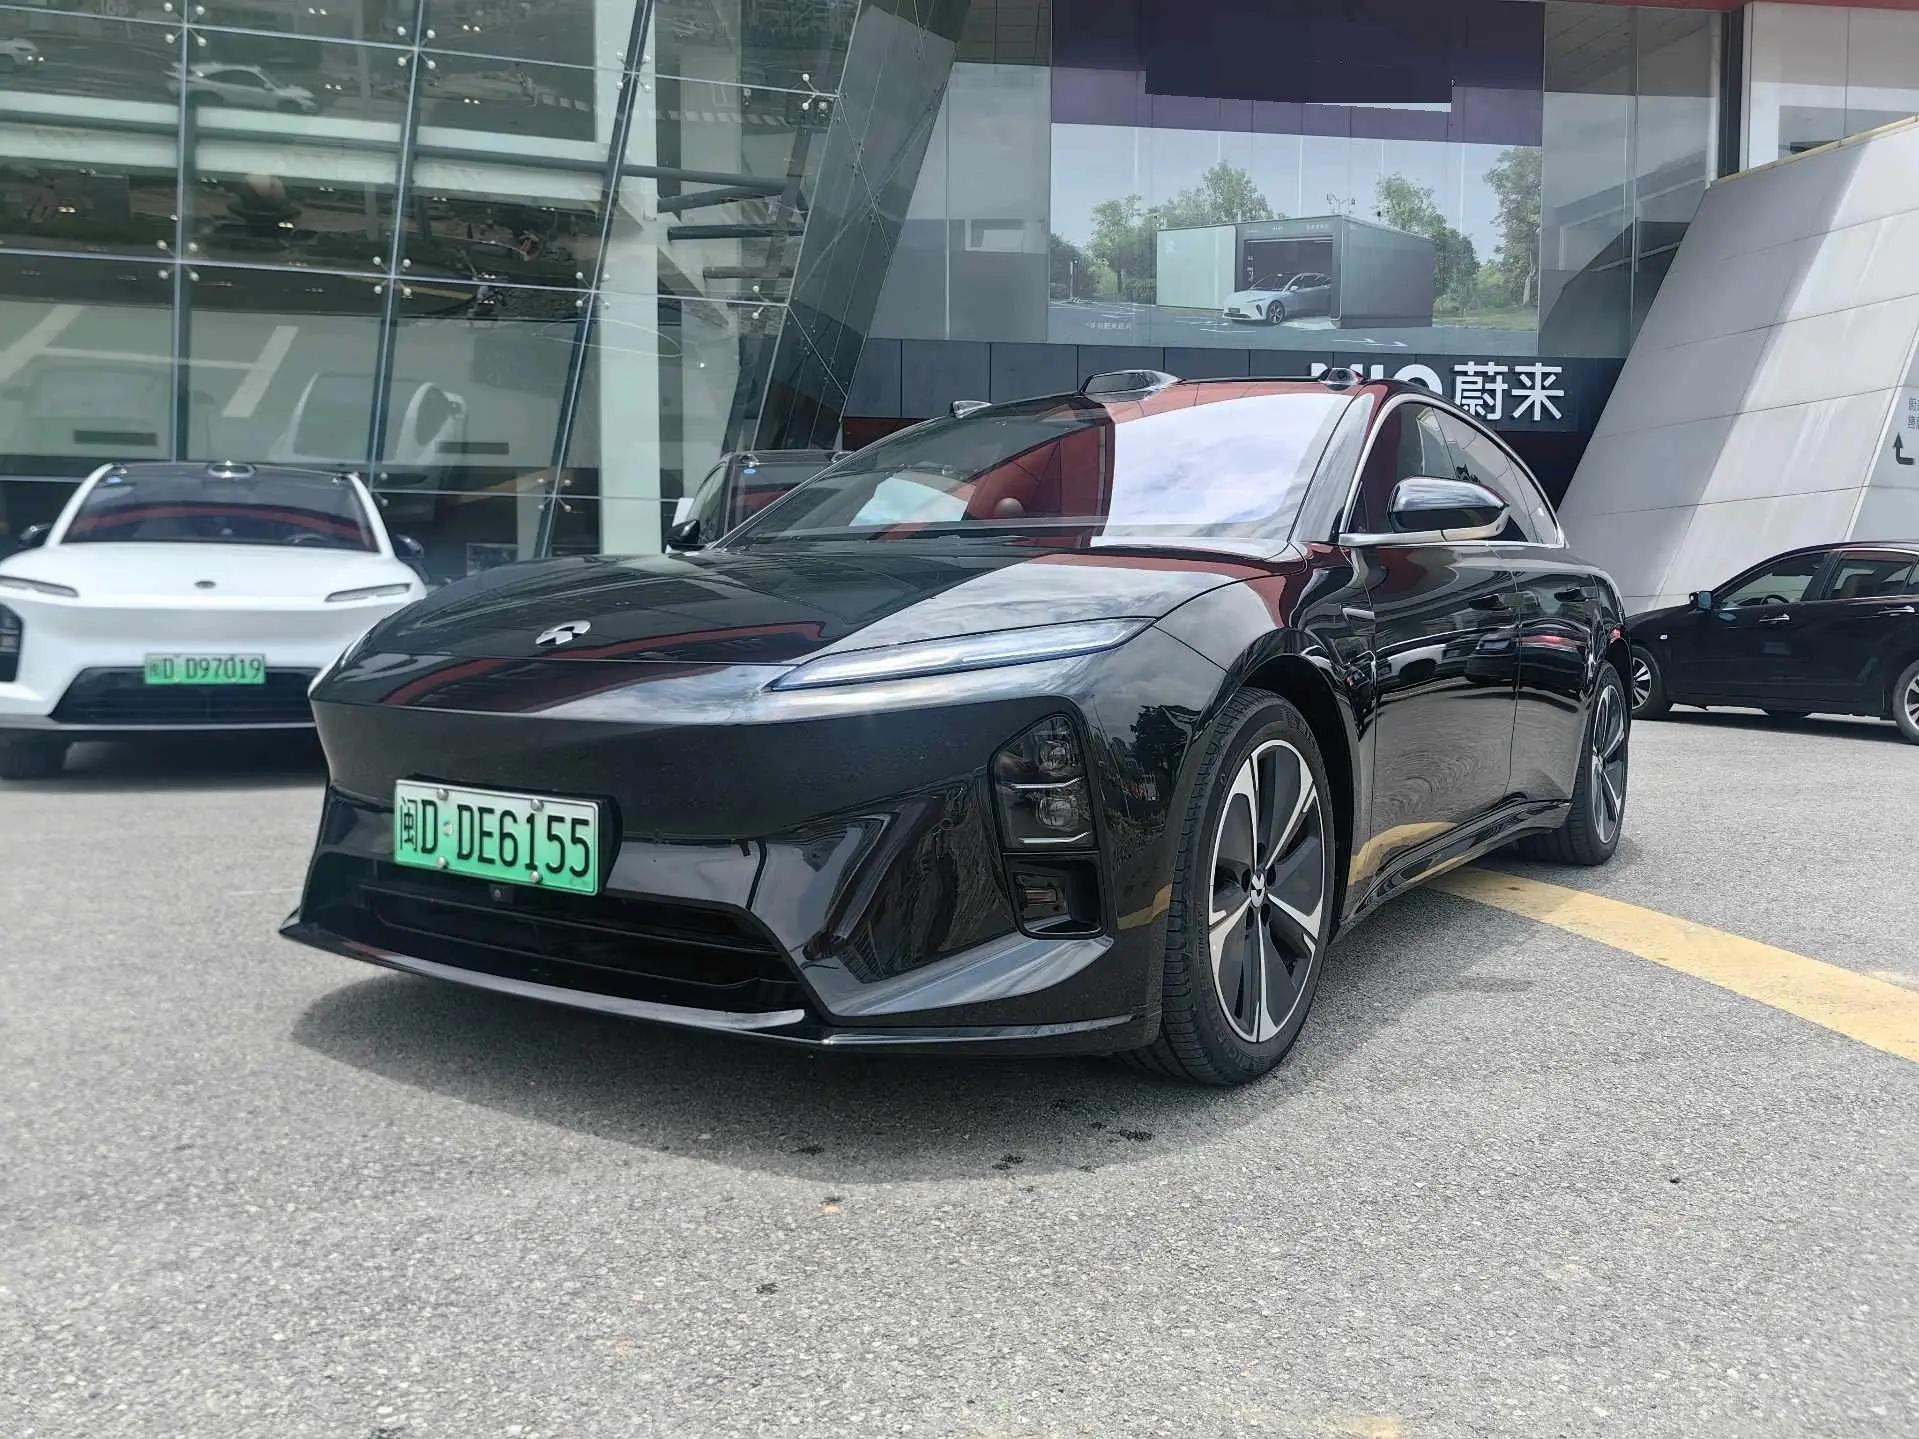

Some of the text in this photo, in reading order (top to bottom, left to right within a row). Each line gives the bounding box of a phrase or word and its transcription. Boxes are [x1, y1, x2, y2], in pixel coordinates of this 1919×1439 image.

[1453, 360, 1565, 421] 蔚来
[185, 657, 262, 680] D97019
[456, 803, 590, 878] DE6155
